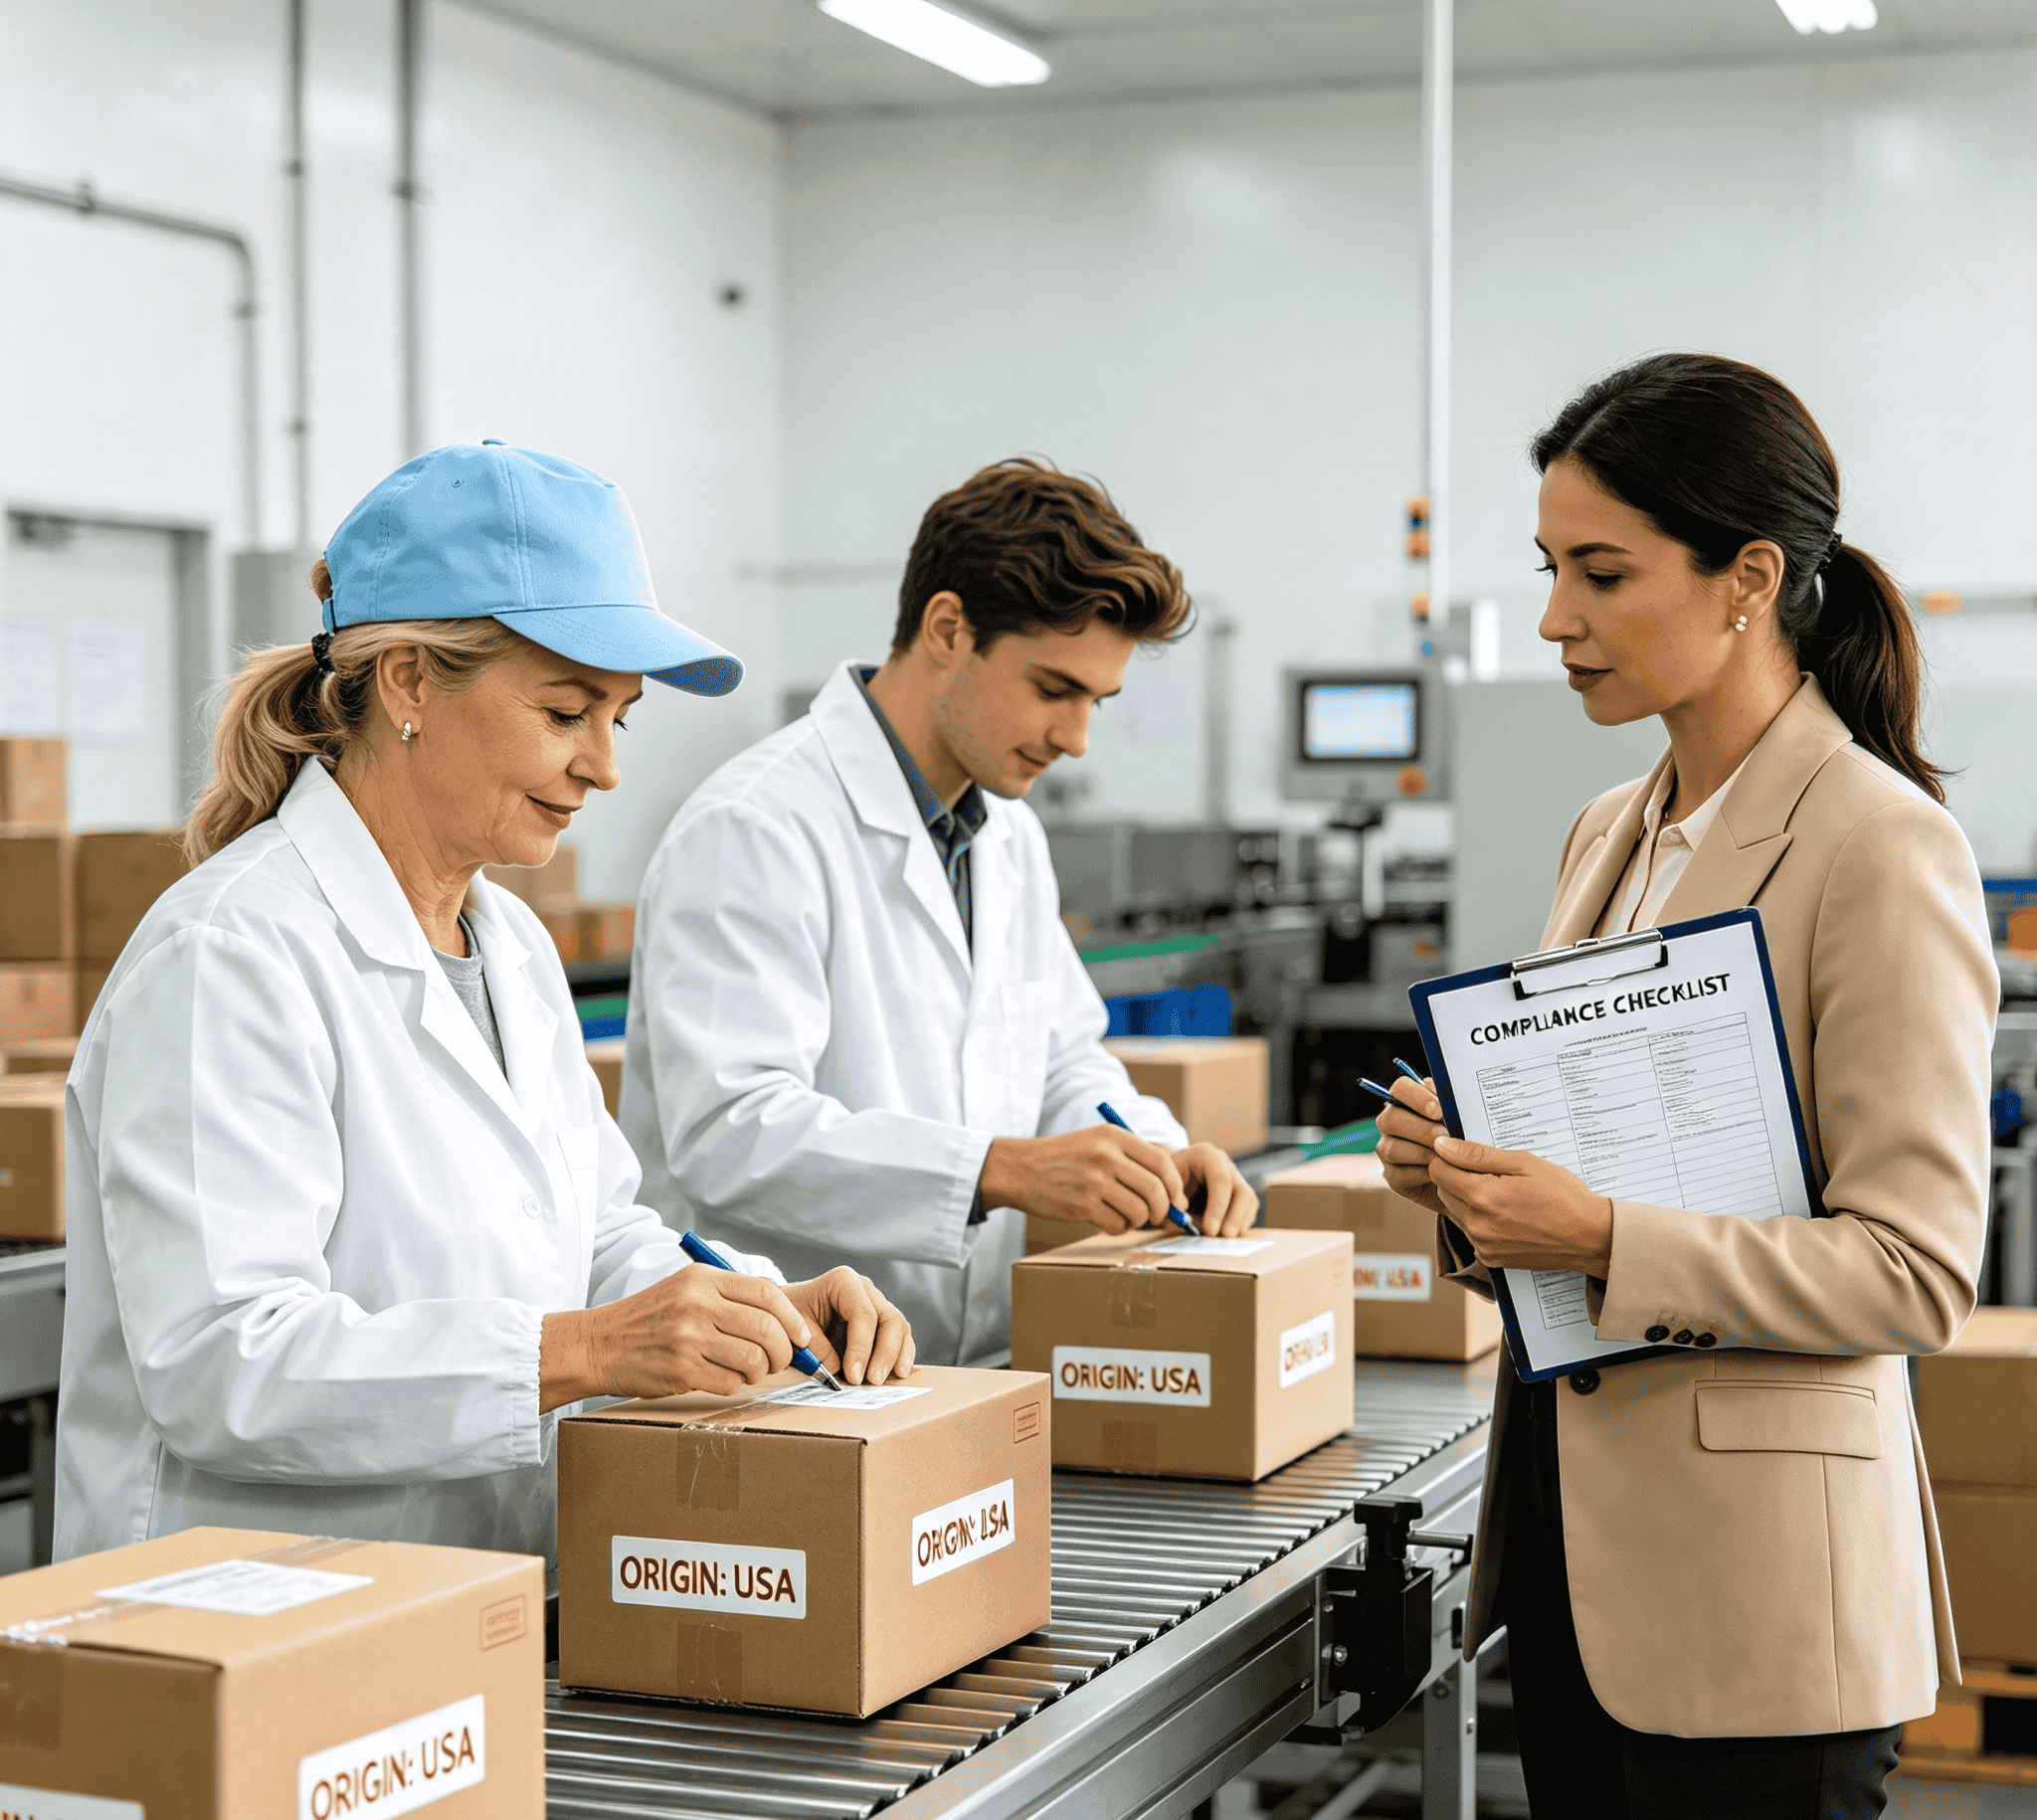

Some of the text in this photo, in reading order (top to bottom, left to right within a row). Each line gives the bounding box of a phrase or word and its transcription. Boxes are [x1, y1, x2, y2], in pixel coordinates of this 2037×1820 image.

[1470, 1001, 1606, 1045] COMPLIANCE
[1613, 974, 1731, 1014] CHECKLIST
[1060, 1362, 1202, 1395] ORIGIN: USA
[620, 1555, 797, 1603] ORIGIN: USA
[310, 1726, 475, 1820] ORIGIN: USA
